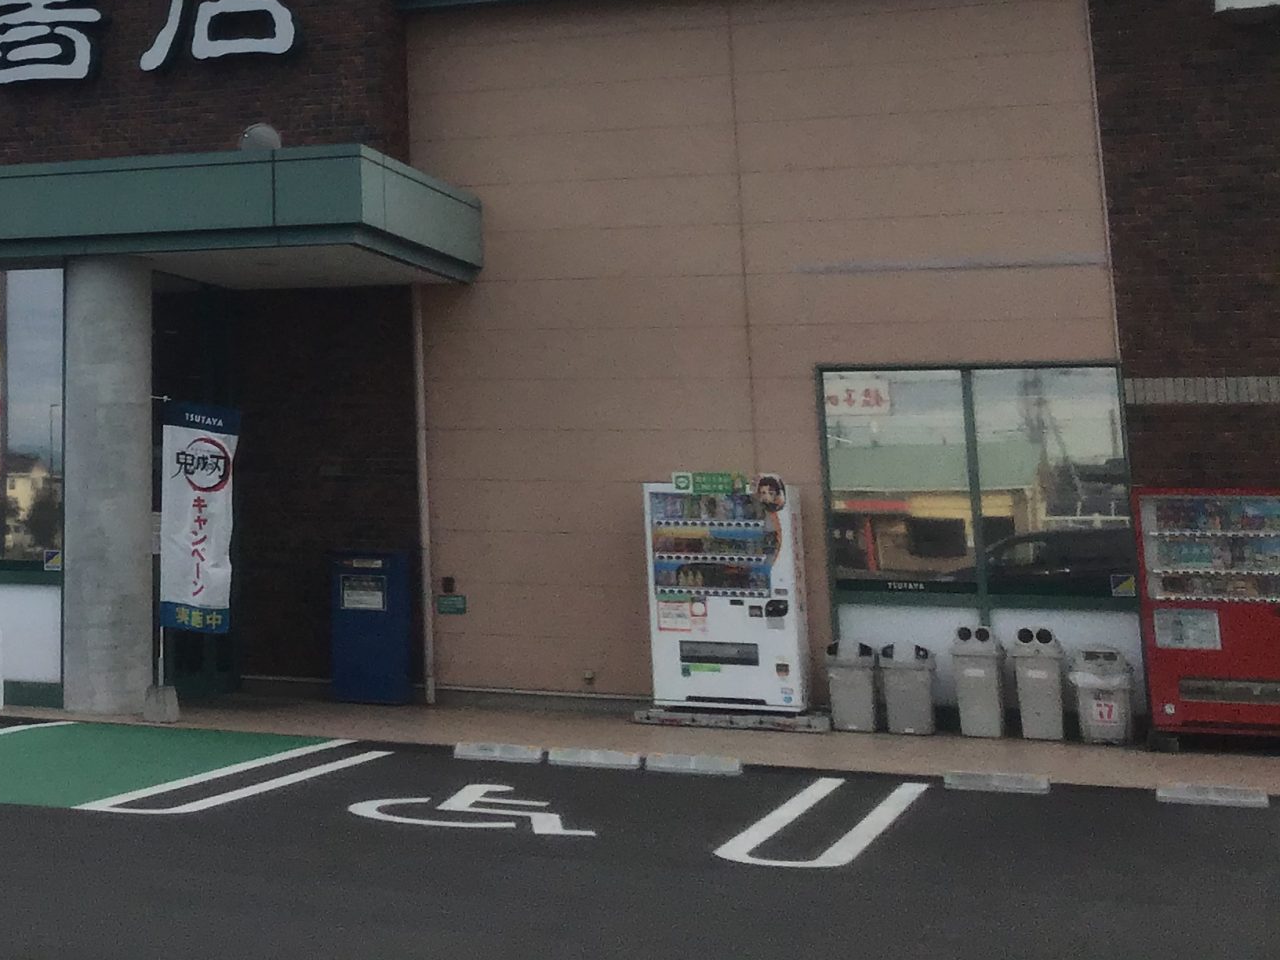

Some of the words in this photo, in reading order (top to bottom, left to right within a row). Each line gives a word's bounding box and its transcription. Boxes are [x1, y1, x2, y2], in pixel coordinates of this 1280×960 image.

[185, 412, 224, 427] TSUTAYA
[191, 496, 208, 597] キャンペーン
